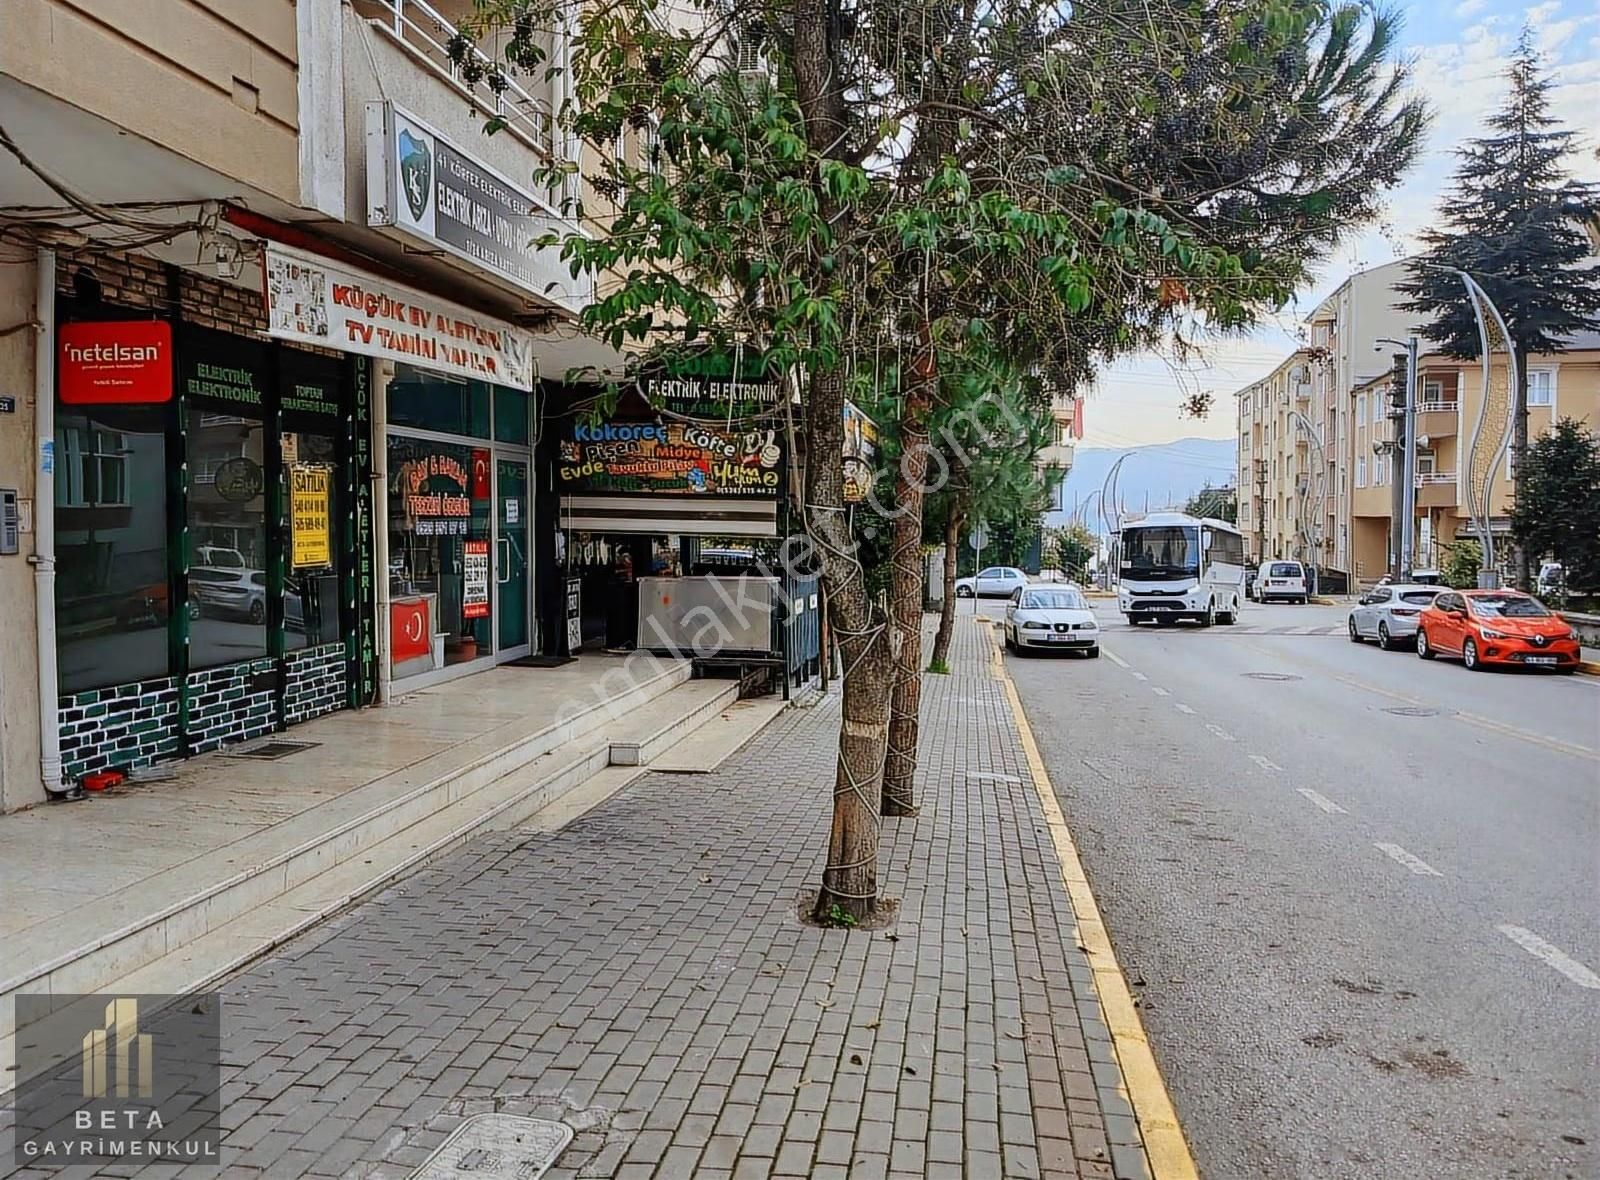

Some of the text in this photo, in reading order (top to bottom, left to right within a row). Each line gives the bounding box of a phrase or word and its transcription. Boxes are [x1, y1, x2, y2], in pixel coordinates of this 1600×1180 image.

[333, 283, 405, 322] KÜÇÜK
[408, 305, 432, 328] EV
[345, 319, 373, 344] TV
[377, 327, 437, 360] TAMİRİ
[70, 342, 158, 362] netelsan
[197, 363, 253, 385] ELEKTRİK
[187, 379, 262, 404] ELEKTRONİK
[710, 381, 778, 402] ELEKTRONİK
[575, 423, 668, 444] Kokoreç
[684, 427, 736, 457] Köfte
[586, 440, 641, 463] Pişen
[655, 445, 701, 460] Midye
[560, 461, 605, 481] Evde
